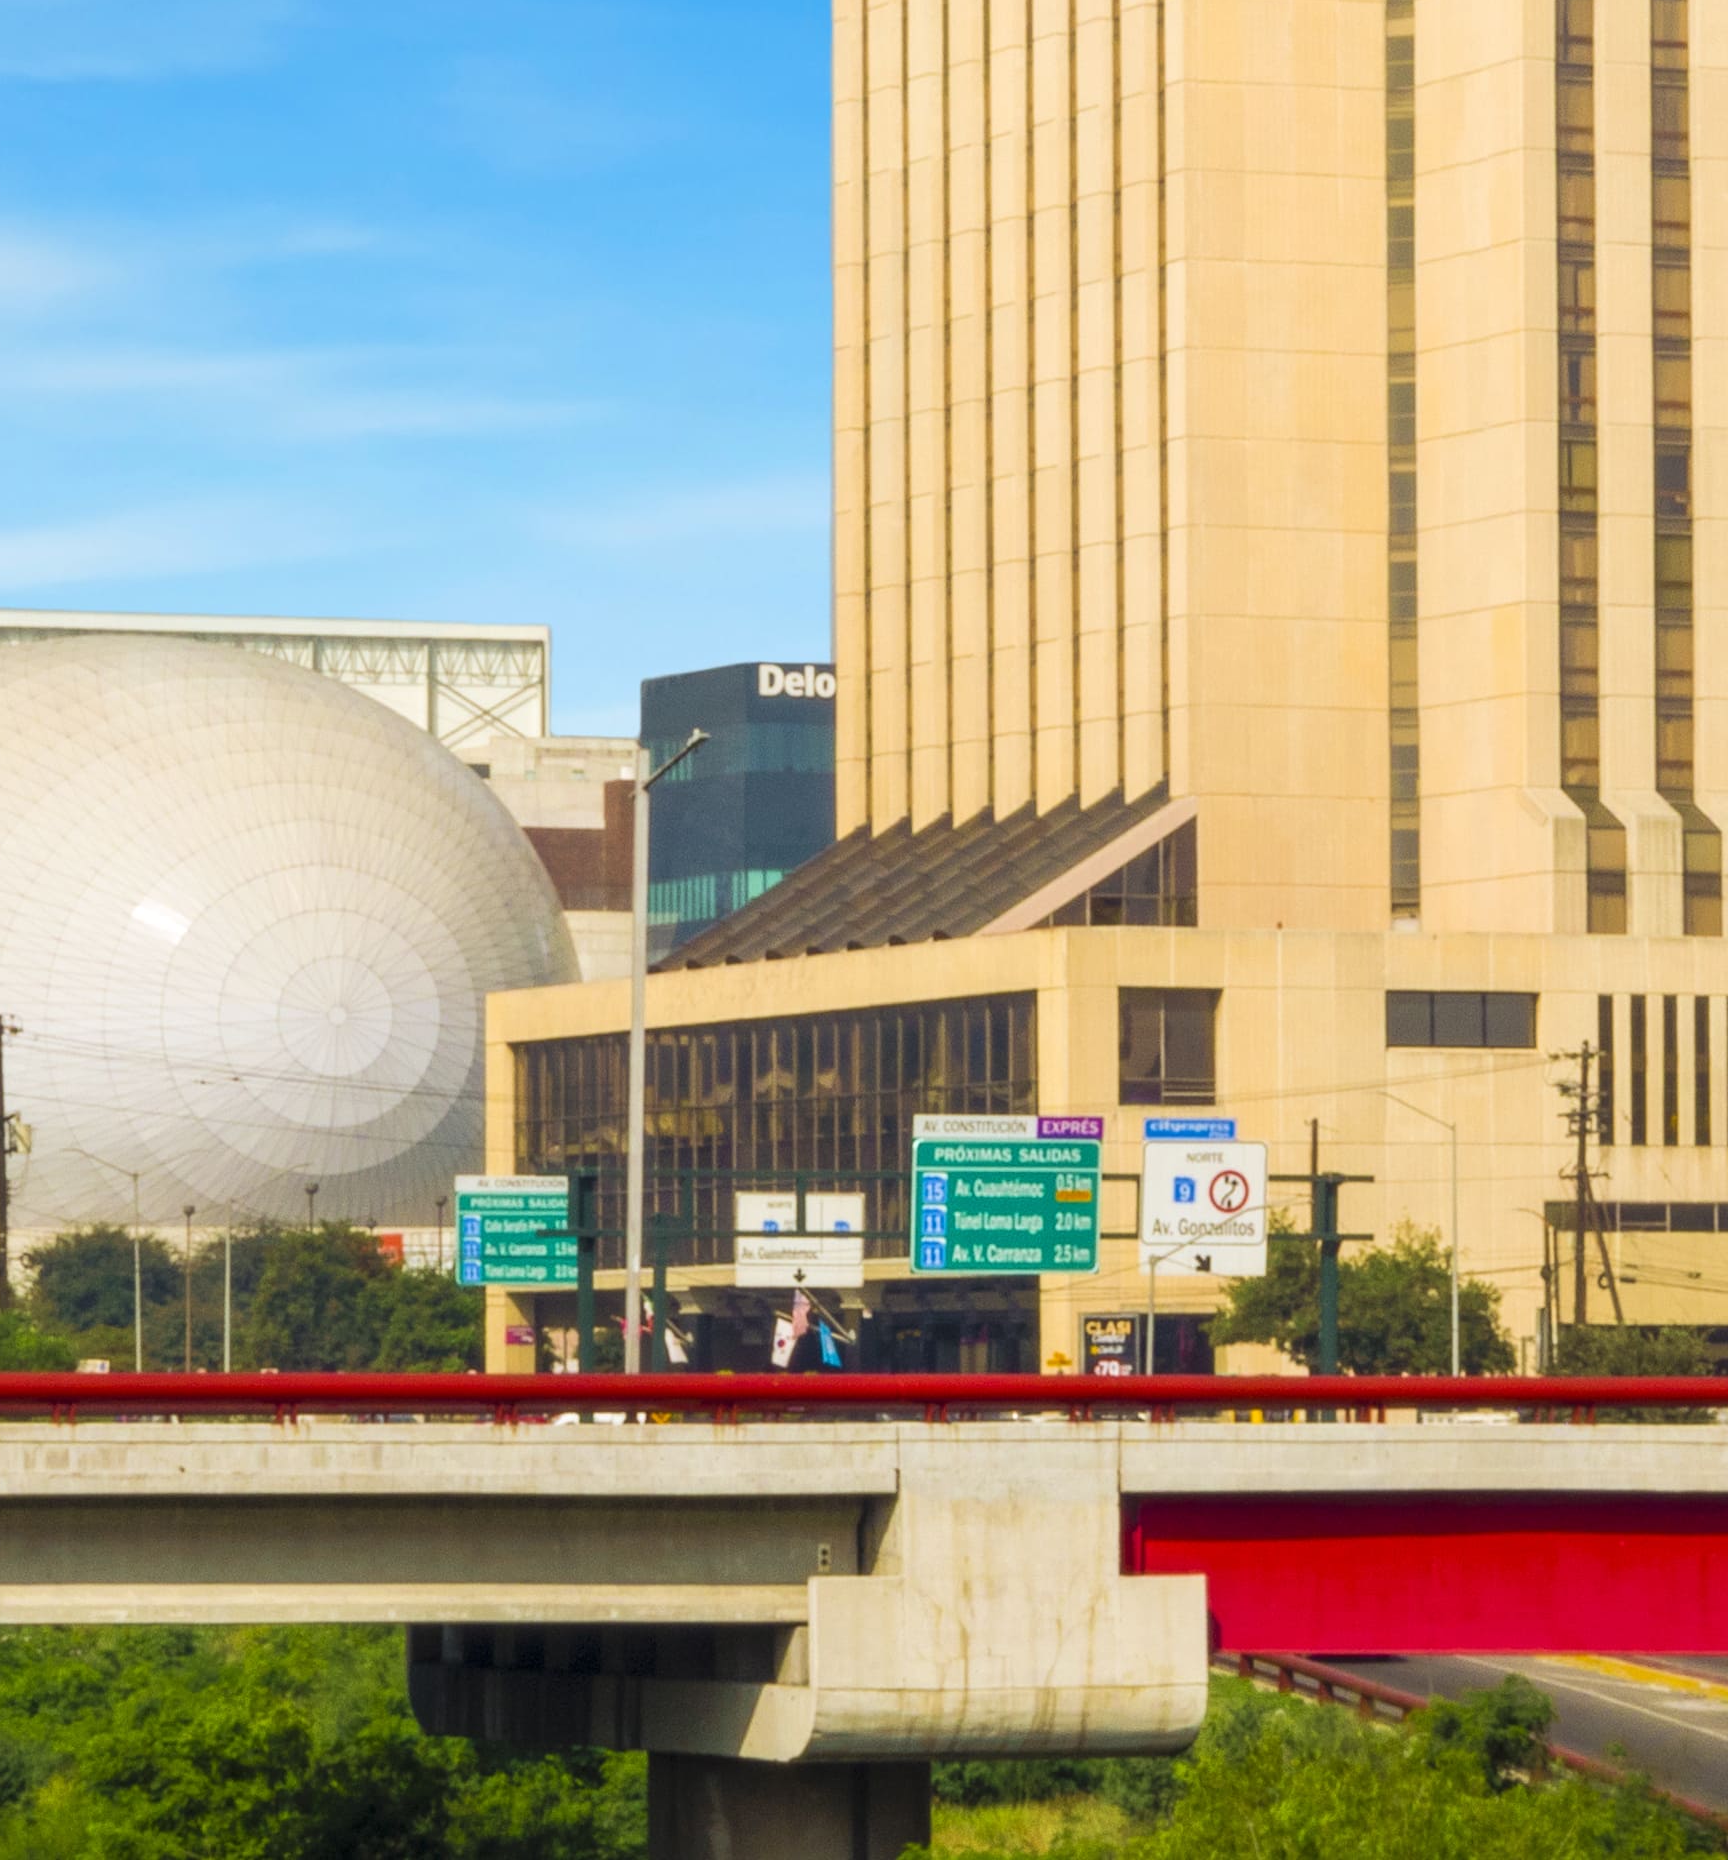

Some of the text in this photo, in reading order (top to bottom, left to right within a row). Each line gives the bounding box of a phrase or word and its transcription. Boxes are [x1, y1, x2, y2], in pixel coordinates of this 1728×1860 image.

[944, 1119, 1026, 1133] CONSTITUCIÓN
[1042, 1119, 1099, 1135] EXPRÉS
[935, 1146, 1081, 1162] PRÓXIMAS SALIDAS
[1186, 1152, 1223, 1163] NORTE
[955, 1180, 971, 1197] Av.
[974, 1179, 1044, 1198] Cuauhtémoc
[1075, 1174, 1092, 1190] km
[926, 1183, 944, 1201] 15
[1179, 1184, 1191, 1201] 9
[926, 1216, 943, 1232] 11
[984, 1213, 1013, 1230] Loma
[1074, 1213, 1091, 1230] km
[1152, 1218, 1254, 1236] Av. Gonzalitos
[924, 1247, 942, 1264] 11
[952, 1245, 1042, 1263] Av. V. Carranza
[1073, 1246, 1090, 1262] km
